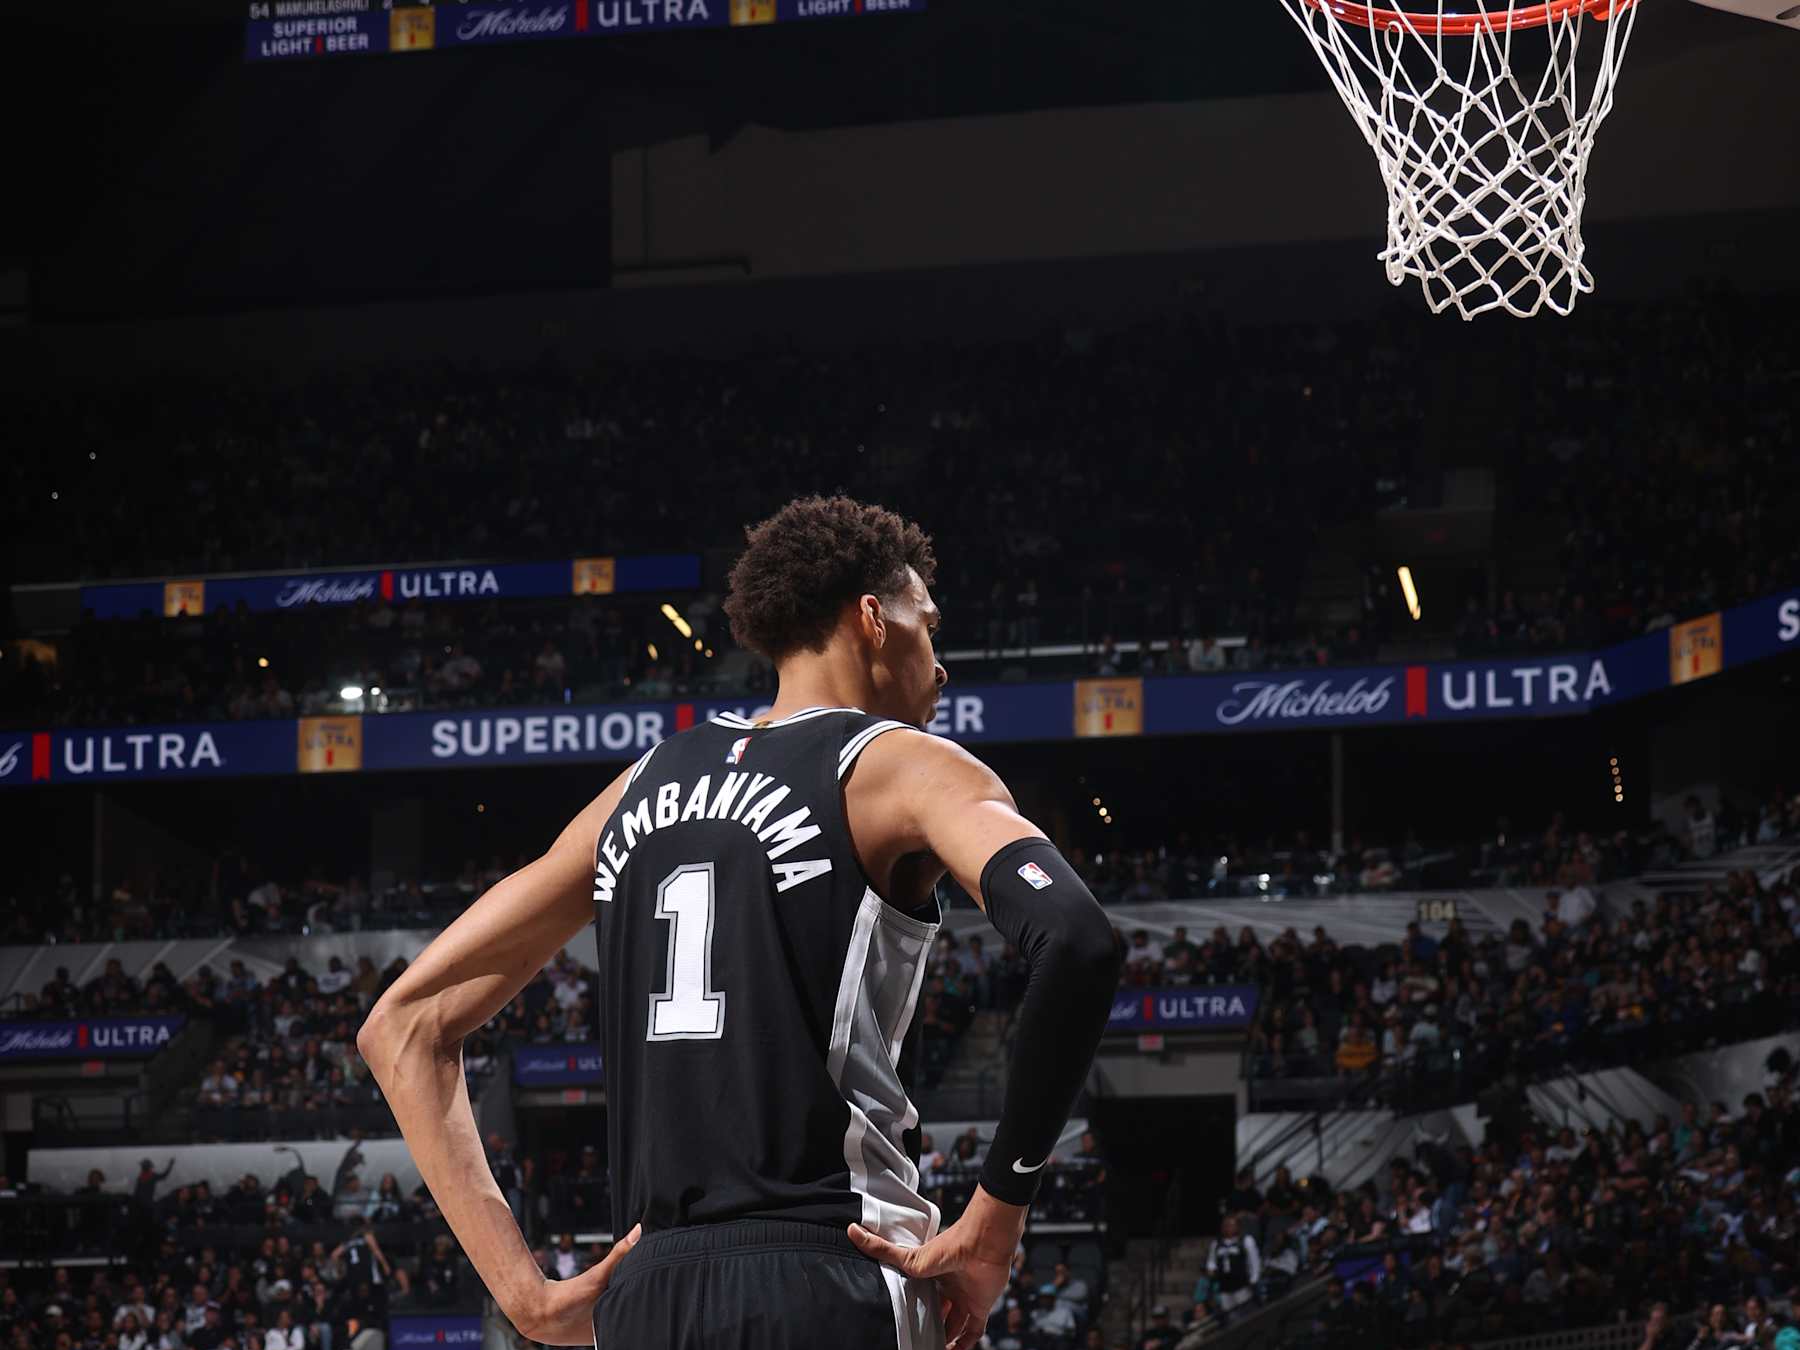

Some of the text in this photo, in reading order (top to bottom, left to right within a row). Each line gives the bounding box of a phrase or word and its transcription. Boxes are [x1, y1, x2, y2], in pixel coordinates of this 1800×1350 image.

[272, 16, 357, 39] SUPERIOR
[598, 0, 709, 27] ULTRA
[261, 33, 369, 57] LIGHT BEER
[400, 570, 499, 599] ULTRA
[1215, 660, 1611, 725] Michelob ULTRA
[431, 695, 985, 758] SUPERIOR ER
[64, 731, 222, 774] ULTRA
[593, 771, 833, 903] WEMBANYAMA
[1419, 901, 1455, 920] 104
[646, 861, 726, 1043] 1
[1158, 996, 1246, 1019] ULTRA
[93, 1025, 170, 1048] ULTRA
